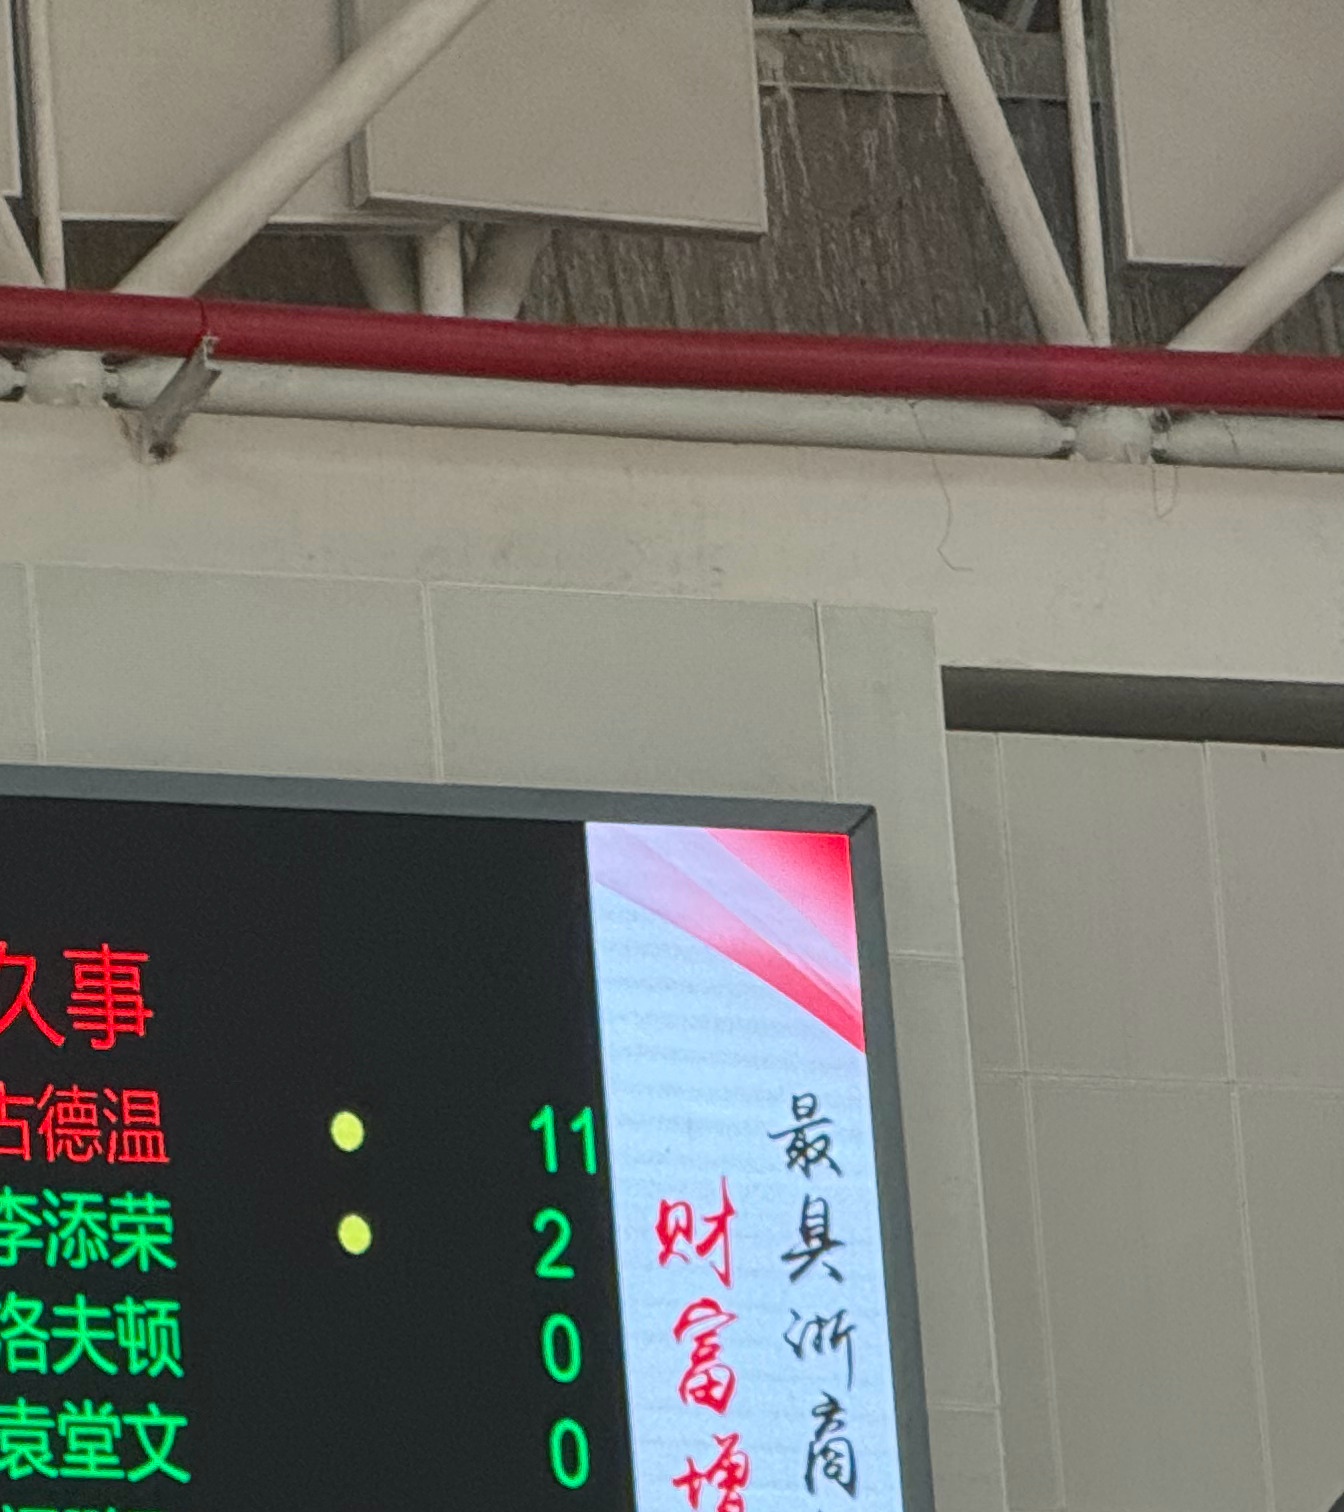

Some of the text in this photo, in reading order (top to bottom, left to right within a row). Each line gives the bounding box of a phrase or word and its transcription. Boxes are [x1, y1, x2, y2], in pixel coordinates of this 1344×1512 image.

[531, 1105, 596, 1174] 11
[534, 1208, 574, 1278] 2
[543, 1314, 580, 1382] 0
[550, 1418, 589, 1488] 0
